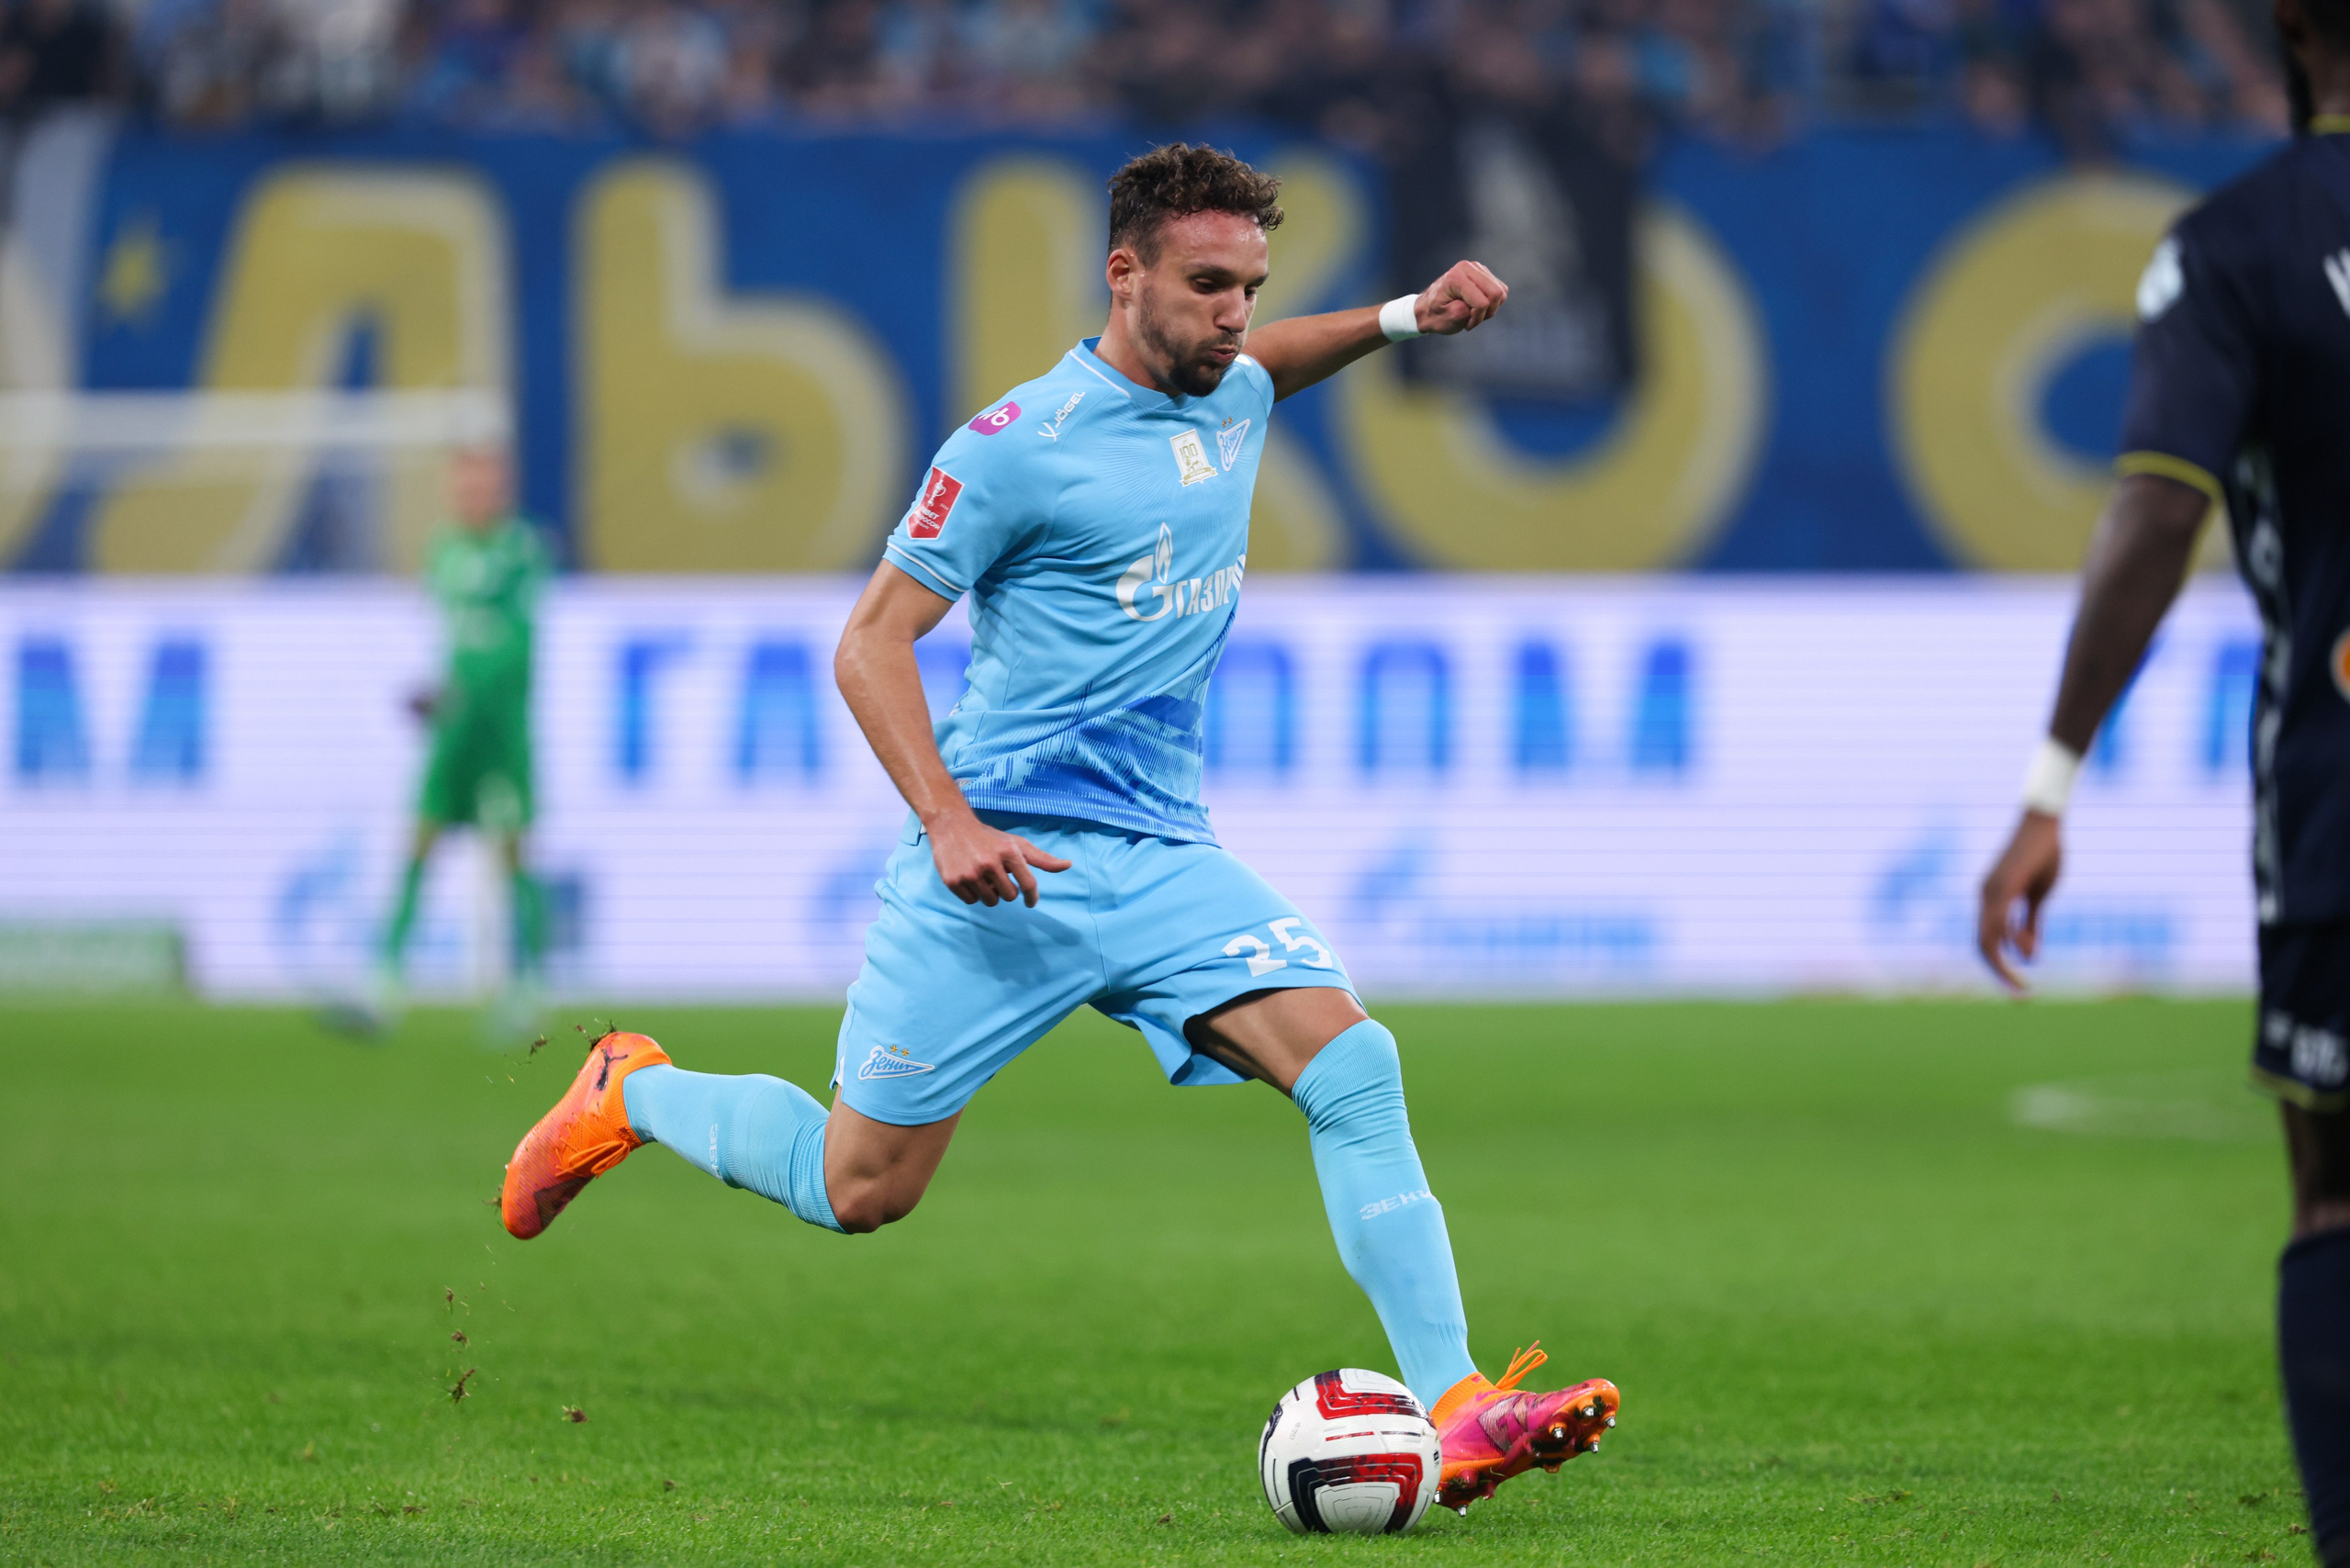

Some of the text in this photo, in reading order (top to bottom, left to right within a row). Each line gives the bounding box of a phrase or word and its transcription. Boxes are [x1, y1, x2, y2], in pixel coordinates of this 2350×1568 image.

[1055, 391, 1086, 429] JÖGEL
[1221, 917, 1334, 978] 25
[1359, 1190, 1432, 1220] ЗЕНИ
